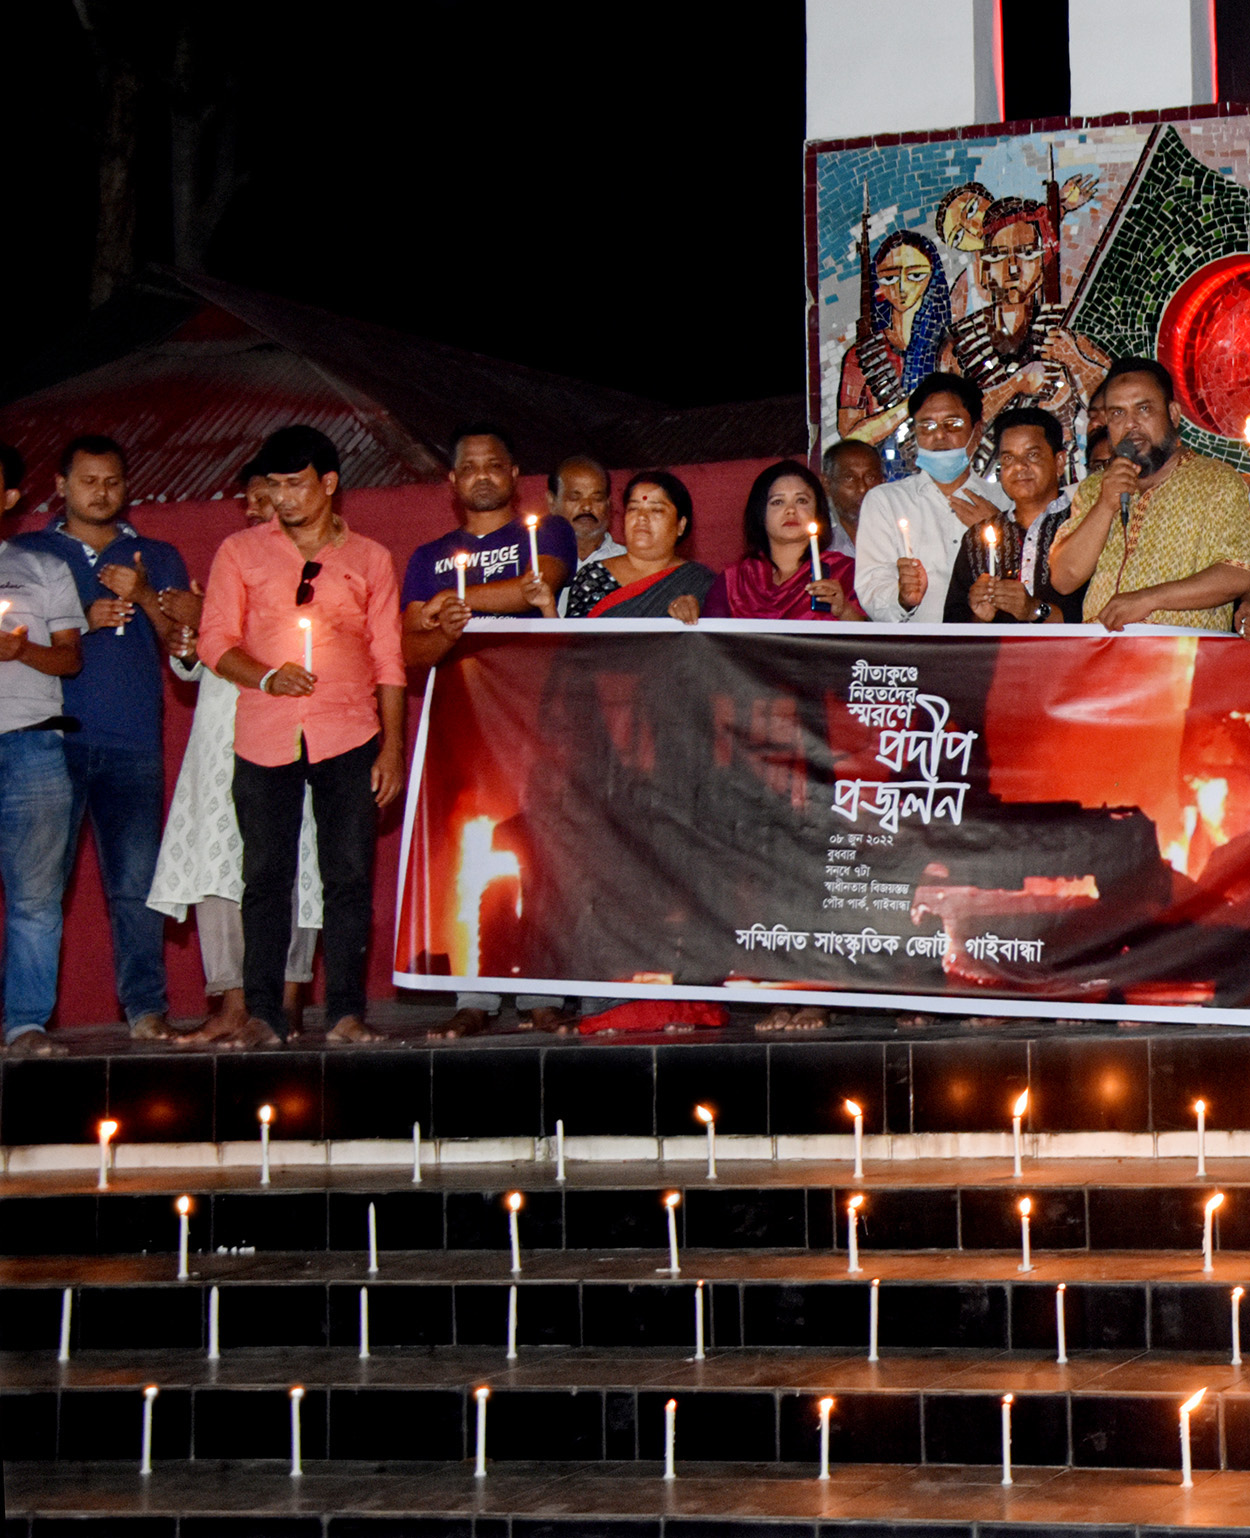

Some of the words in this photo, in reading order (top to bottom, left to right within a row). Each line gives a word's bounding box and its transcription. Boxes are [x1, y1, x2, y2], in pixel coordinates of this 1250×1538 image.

[851, 659, 919, 687] সীতাকুণ্ডে
[849, 681, 919, 704] নিহতদের
[846, 702, 917, 728] স্মরণে
[875, 693, 979, 783] প্রদীপ
[831, 778, 971, 834] প্রজ্বলন
[829, 834, 844, 844] ০৮
[847, 833, 864, 847] জুন
[866, 834, 894, 847] ২০২২
[827, 849, 857, 862] বুধবার
[854, 864, 871, 877] ৭টা
[824, 878, 868, 893] স্বাধীনতার
[822, 895, 845, 909] পৌর
[872, 897, 911, 912] গাইবান্ধা
[735, 923, 810, 952] সম্মিলিত
[814, 927, 901, 965] সাংস্কৃতিক
[965, 932, 1045, 963] গাইবান্ধা
